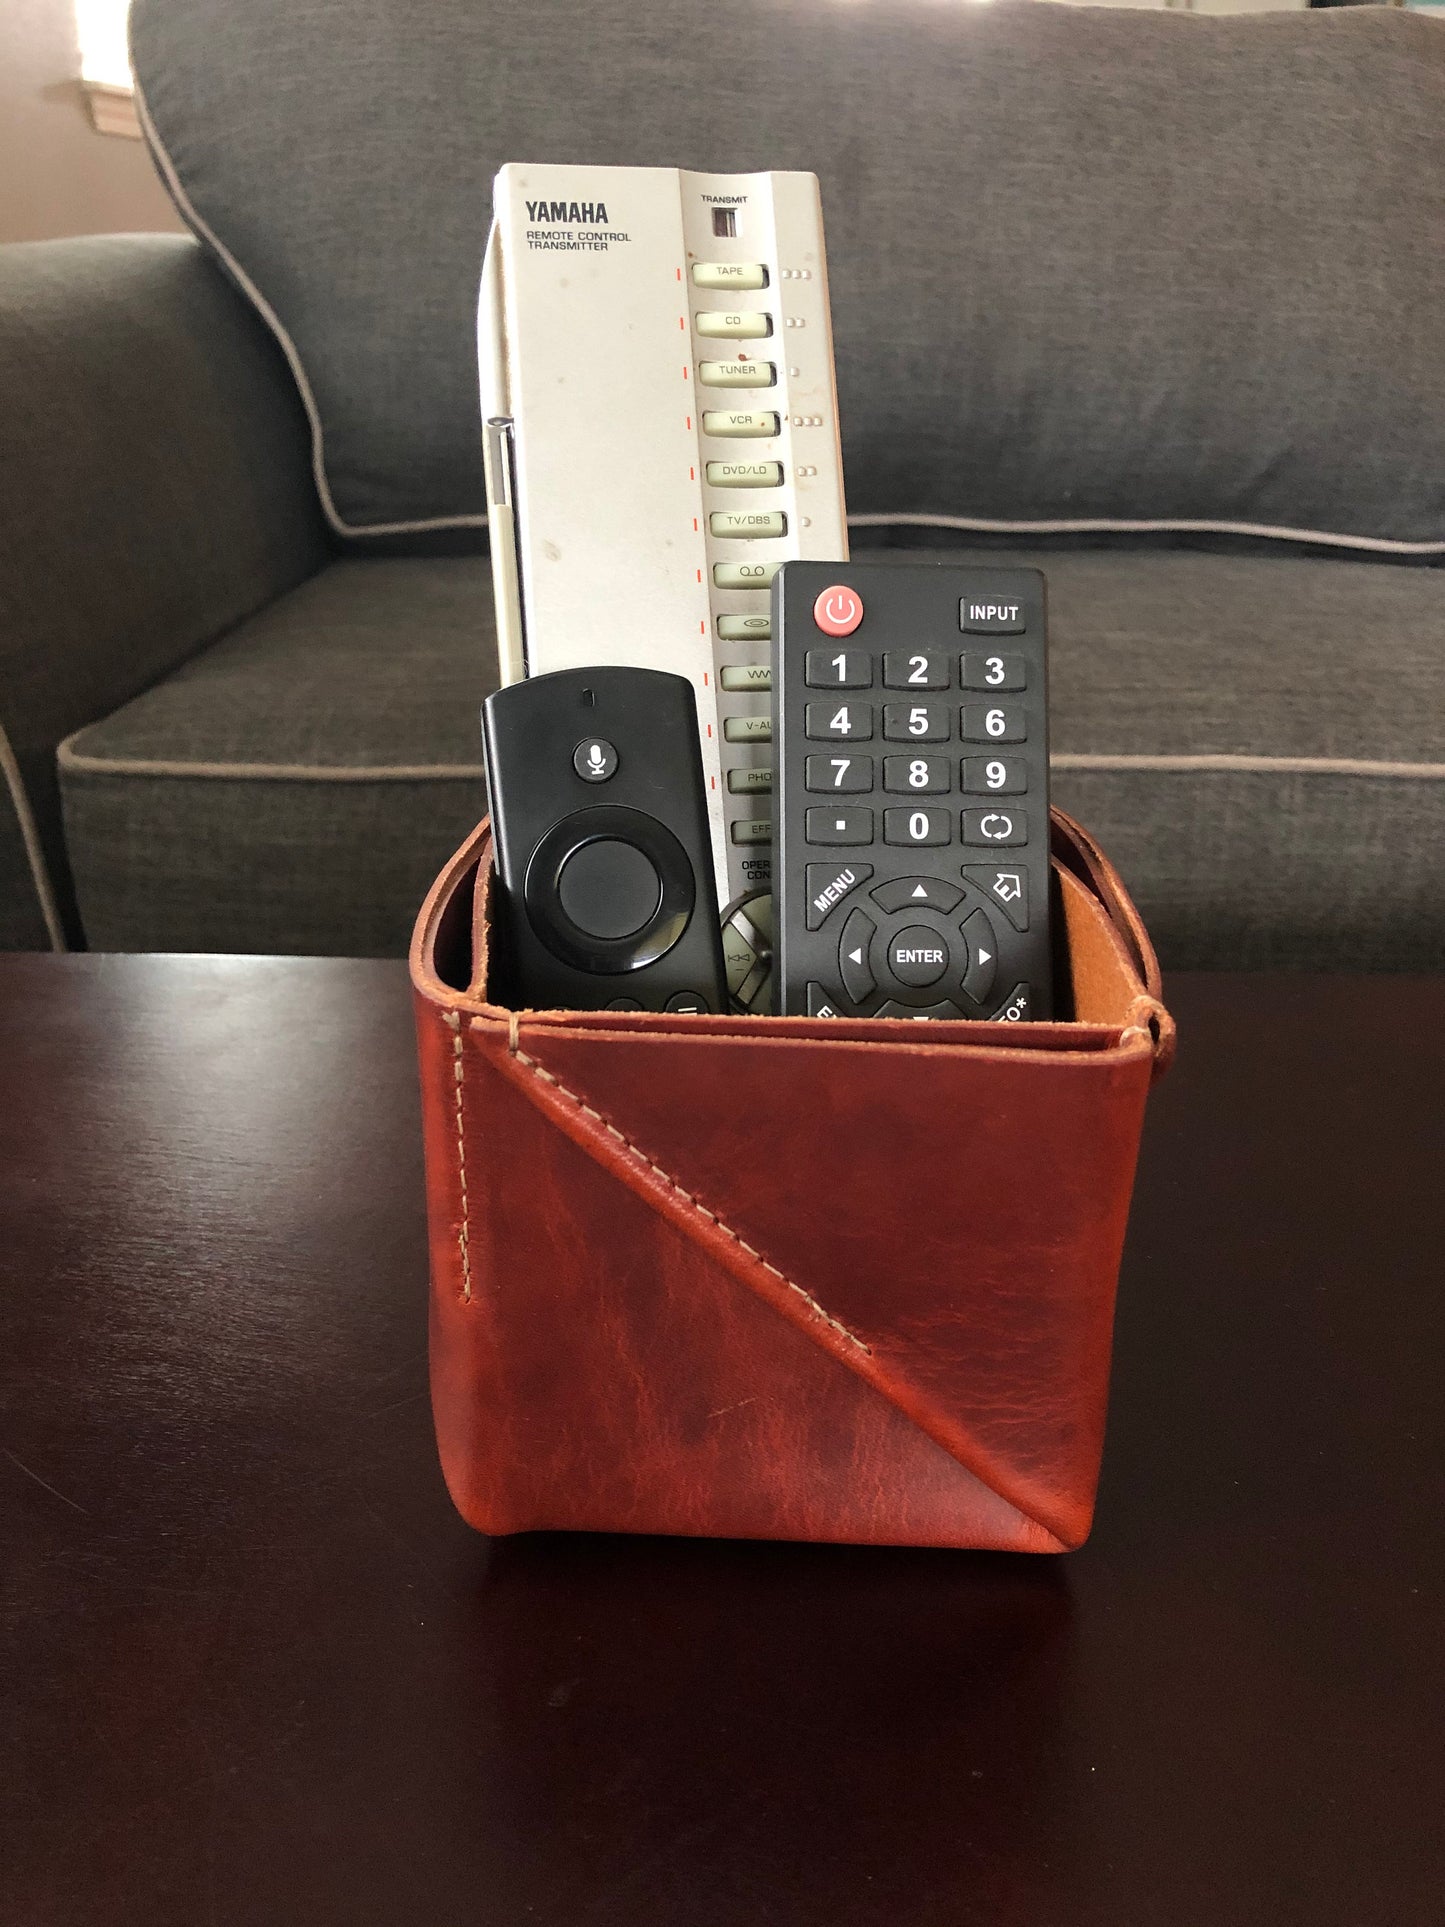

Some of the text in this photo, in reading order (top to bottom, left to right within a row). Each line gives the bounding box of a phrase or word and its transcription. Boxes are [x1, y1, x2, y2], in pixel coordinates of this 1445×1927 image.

[700, 194, 748, 204] TRANSMIT
[525, 200, 609, 224] YAMAHA
[526, 230, 632, 242] REMOTE CONTROL
[527, 240, 608, 251] TRANSMITTER
[716, 266, 744, 276] TAPE
[725, 316, 741, 325] CD
[719, 365, 757, 375] TUNER
[729, 415, 753, 425] VCR
[722, 465, 767, 475] DVD/LD
[727, 515, 771, 525] TV/DBS
[969, 604, 1019, 622] INPUT
[831, 654, 846, 682] 1
[907, 655, 929, 684] 2
[984, 656, 1006, 685] 3
[829, 706, 852, 735] 4
[908, 708, 929, 735] 5
[984, 709, 1006, 737] 6
[830, 759, 851, 787] 7
[908, 759, 930, 788] 8
[985, 761, 1007, 789] 9
[909, 812, 930, 840] 0
[813, 868, 857, 913] MENU
[896, 949, 943, 963] ENTER
